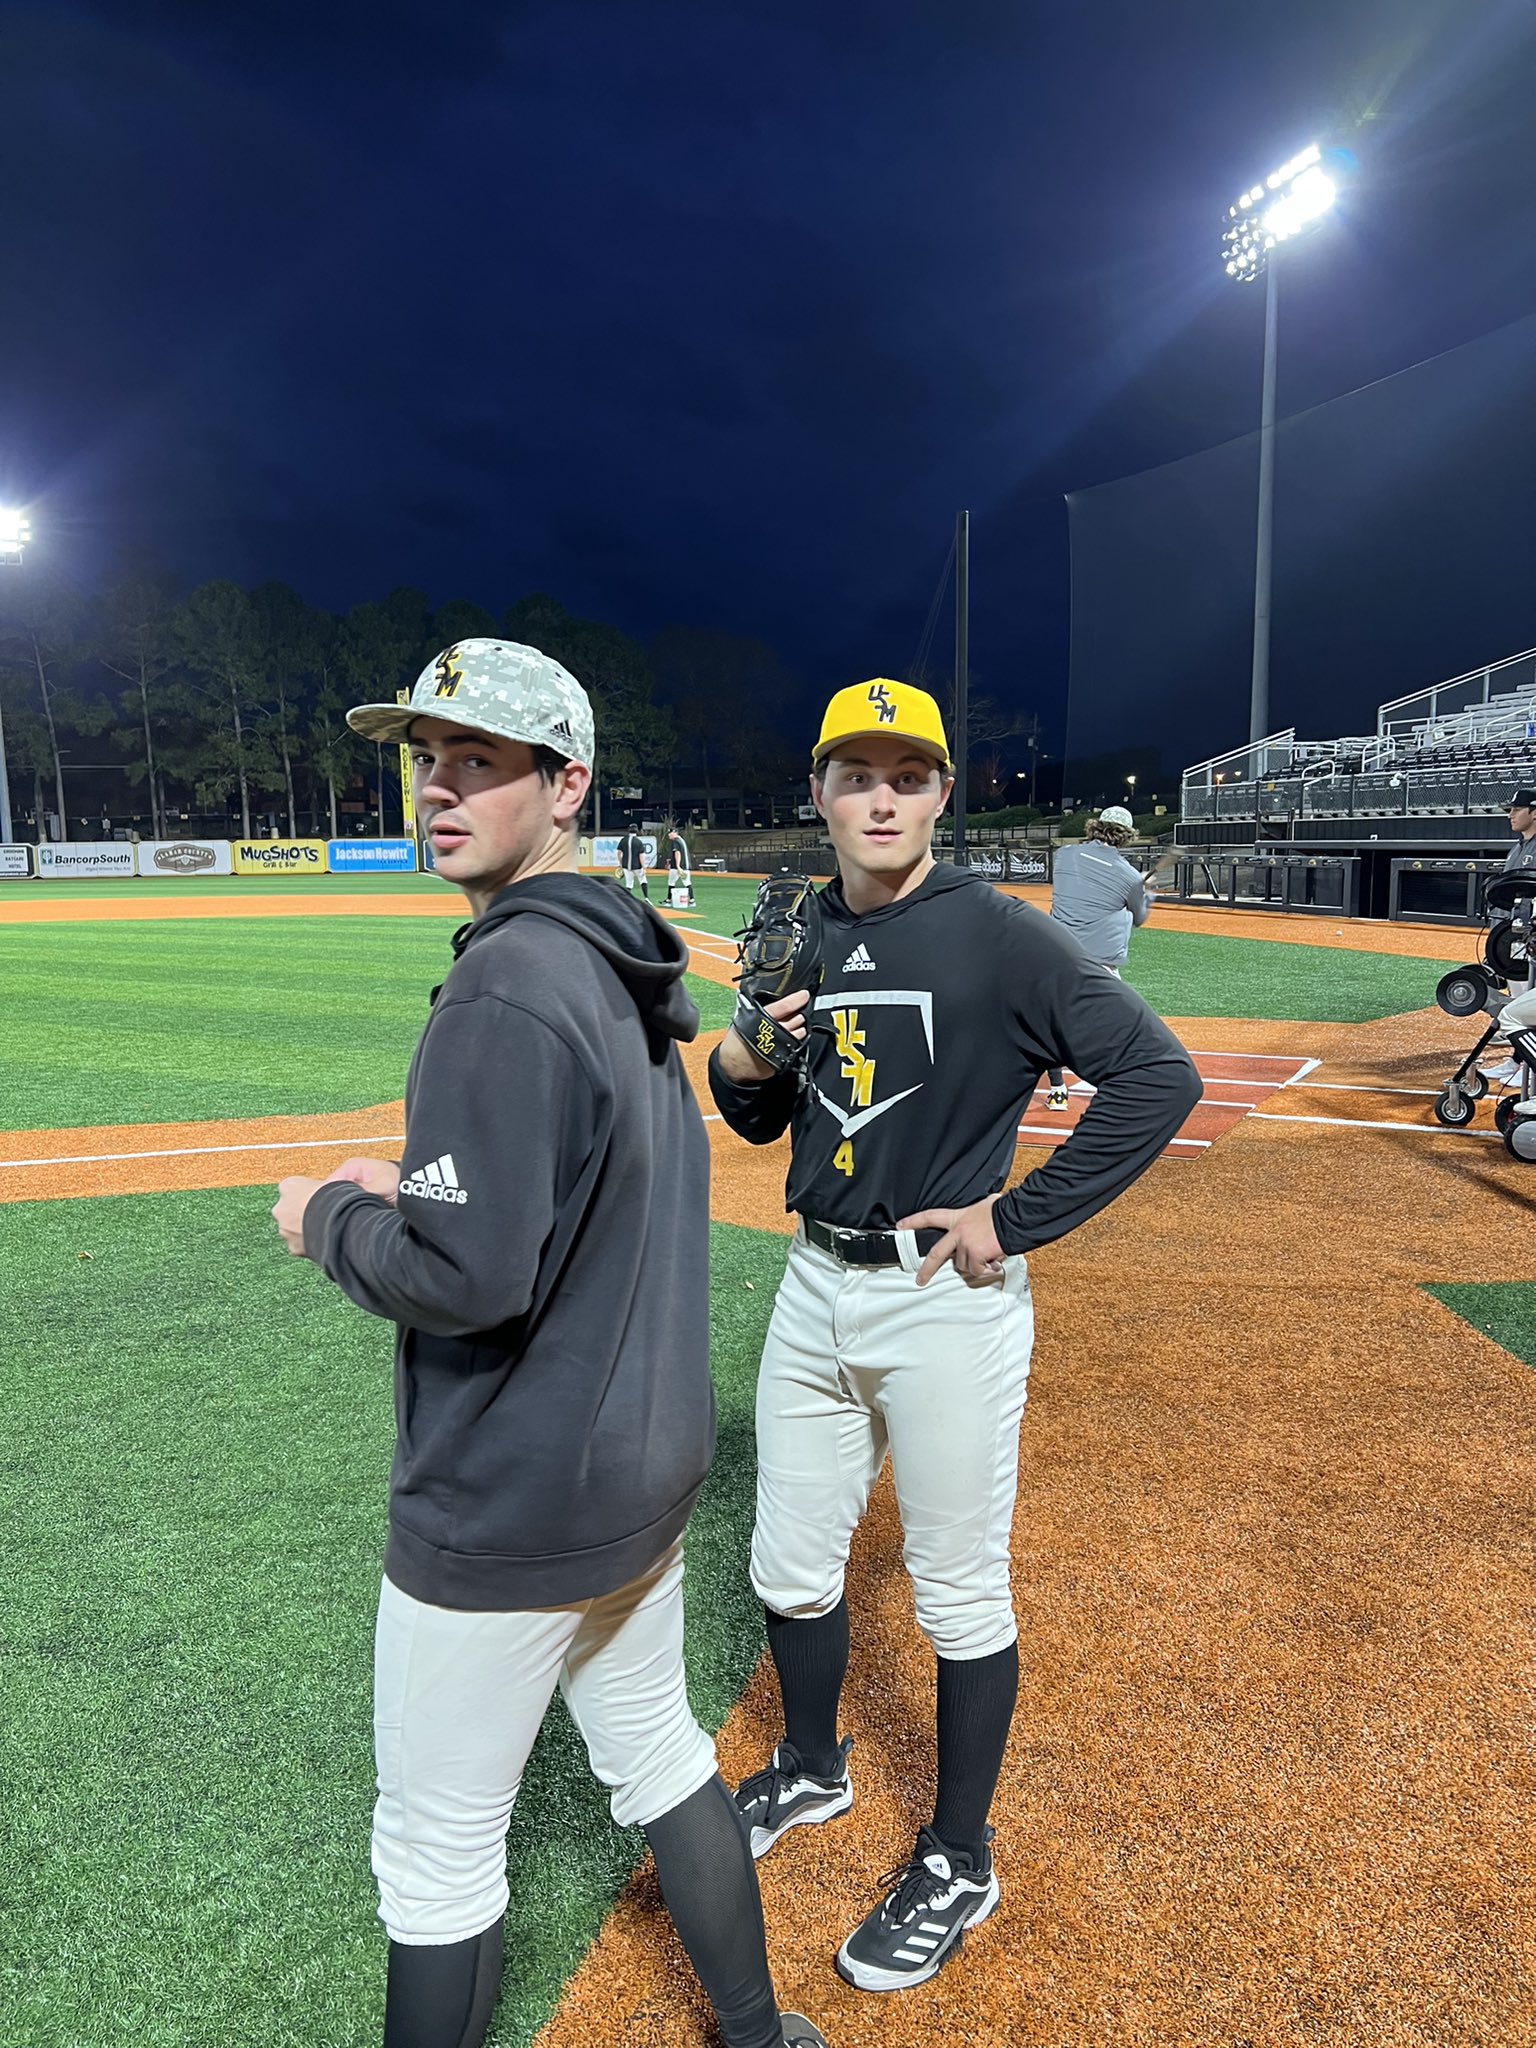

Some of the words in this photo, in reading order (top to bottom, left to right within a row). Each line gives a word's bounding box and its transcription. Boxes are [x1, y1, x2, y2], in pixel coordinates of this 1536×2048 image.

[867, 684, 897, 724] USM
[54, 854, 131, 866] BancorpSouth
[982, 860, 1002, 872] adidas
[1022, 860, 1046, 873] adidas
[842, 960, 876, 973] adidas
[755, 1019, 776, 1055] USM
[832, 1140, 855, 1177] 4
[399, 1180, 469, 1205] adidas
